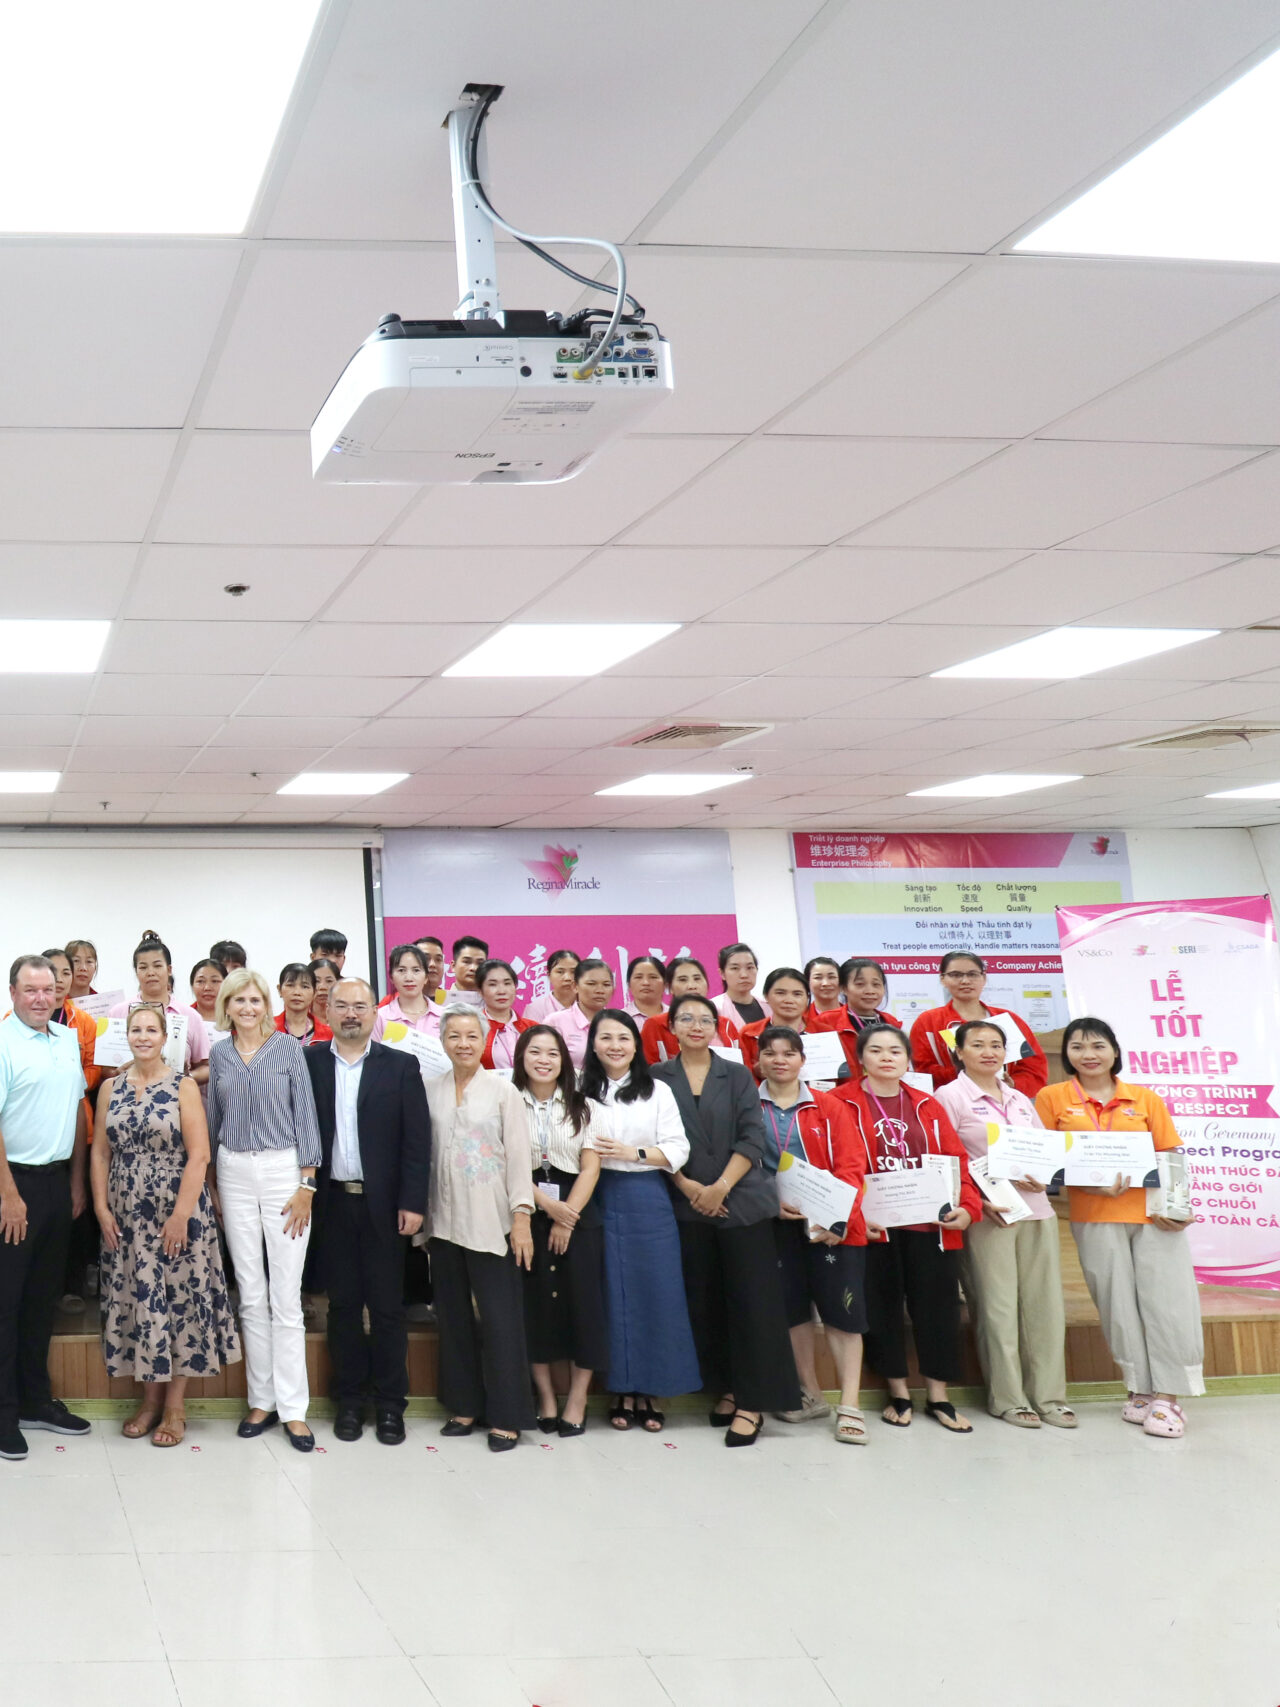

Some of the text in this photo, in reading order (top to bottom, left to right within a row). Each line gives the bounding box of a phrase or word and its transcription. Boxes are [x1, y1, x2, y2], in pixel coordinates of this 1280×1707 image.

[851, 860, 892, 868] Philosophy
[960, 905, 983, 913] Speed
[1006, 905, 1032, 913] Quality
[882, 942, 901, 950] Treat
[903, 942, 927, 950] people
[974, 942, 1000, 950] Handle
[1002, 942, 1029, 950] matters
[1031, 942, 1060, 950] reasona
[1178, 946, 1196, 954] SERI
[909, 962, 930, 972] công
[996, 962, 1036, 971] Company
[1150, 970, 1184, 1001] LỄ
[1150, 1006, 1202, 1037] TỐT
[1128, 1046, 1238, 1080] NGHIỆP
[1202, 1085, 1256, 1098] TRÌNH
[1174, 1103, 1249, 1115] RESPECT
[1204, 1121, 1276, 1146] Ceremony
[1176, 1146, 1280, 1161] pect Progra
[1190, 1163, 1216, 1175] ÌNH
[1220, 1165, 1261, 1177] THÚC
[1228, 1182, 1263, 1193] GIỚI
[1207, 1196, 1256, 1210] CHUỖI
[1210, 1214, 1251, 1226] TOÀN
[1256, 1214, 1280, 1228] CẦ
